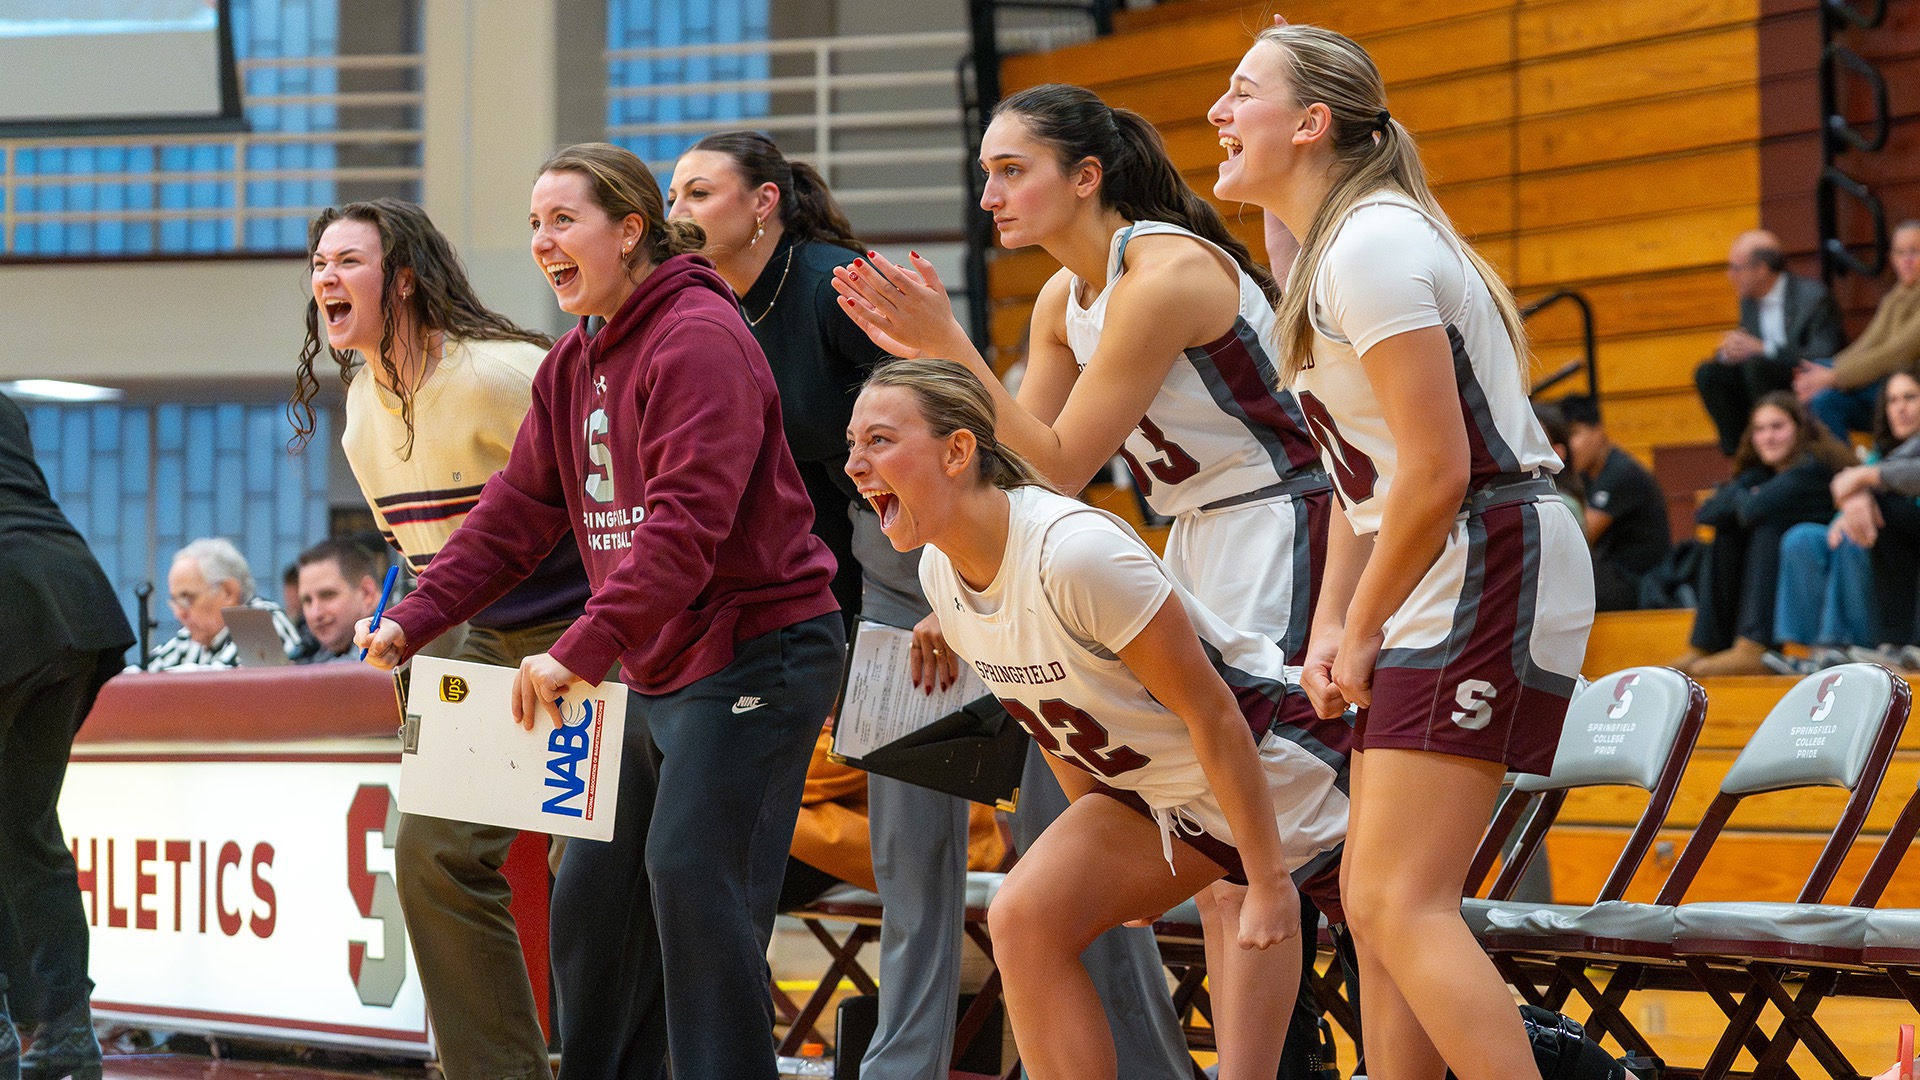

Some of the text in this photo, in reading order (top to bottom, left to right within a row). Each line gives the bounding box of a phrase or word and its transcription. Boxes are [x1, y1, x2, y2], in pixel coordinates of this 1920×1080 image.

[1298, 390, 1379, 511] 0
[974, 660, 1067, 685] SPRINGFIELD
[448, 677, 465, 701] ups
[737, 696, 761, 707] NIKE
[1451, 678, 1498, 731] S
[998, 697, 1152, 778] 22
[1587, 723, 1636, 732] SPRINGFIELD
[1593, 734, 1625, 743] COLLEGE
[1790, 725, 1837, 735] SPRINGFIELD
[593, 726, 601, 756] BASKETBALL
[1594, 745, 1617, 755] PRIDE
[1795, 737, 1826, 747] COLLEGE
[541, 695, 593, 818] NABC
[1796, 749, 1818, 759] PRIDE
[346, 783, 406, 1008] S
